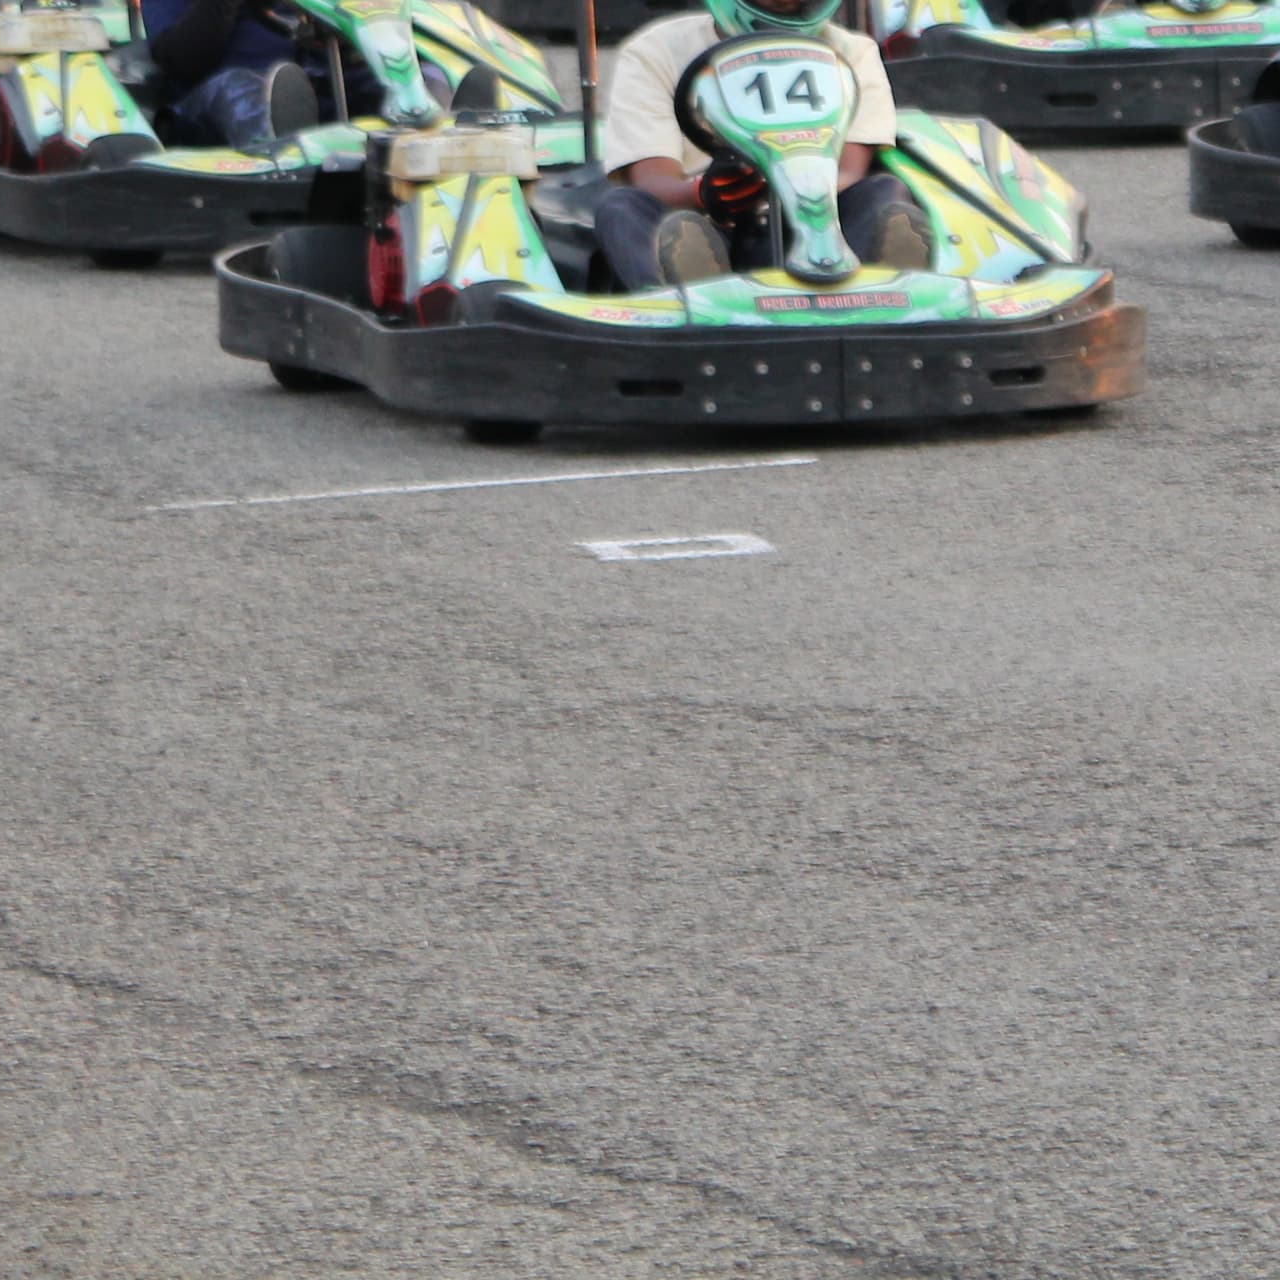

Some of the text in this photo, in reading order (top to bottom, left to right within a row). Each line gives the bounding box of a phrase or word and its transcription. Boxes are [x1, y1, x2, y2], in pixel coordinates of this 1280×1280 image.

[745, 69, 826, 115] 14
[758, 291, 909, 312] RED RIDERS
